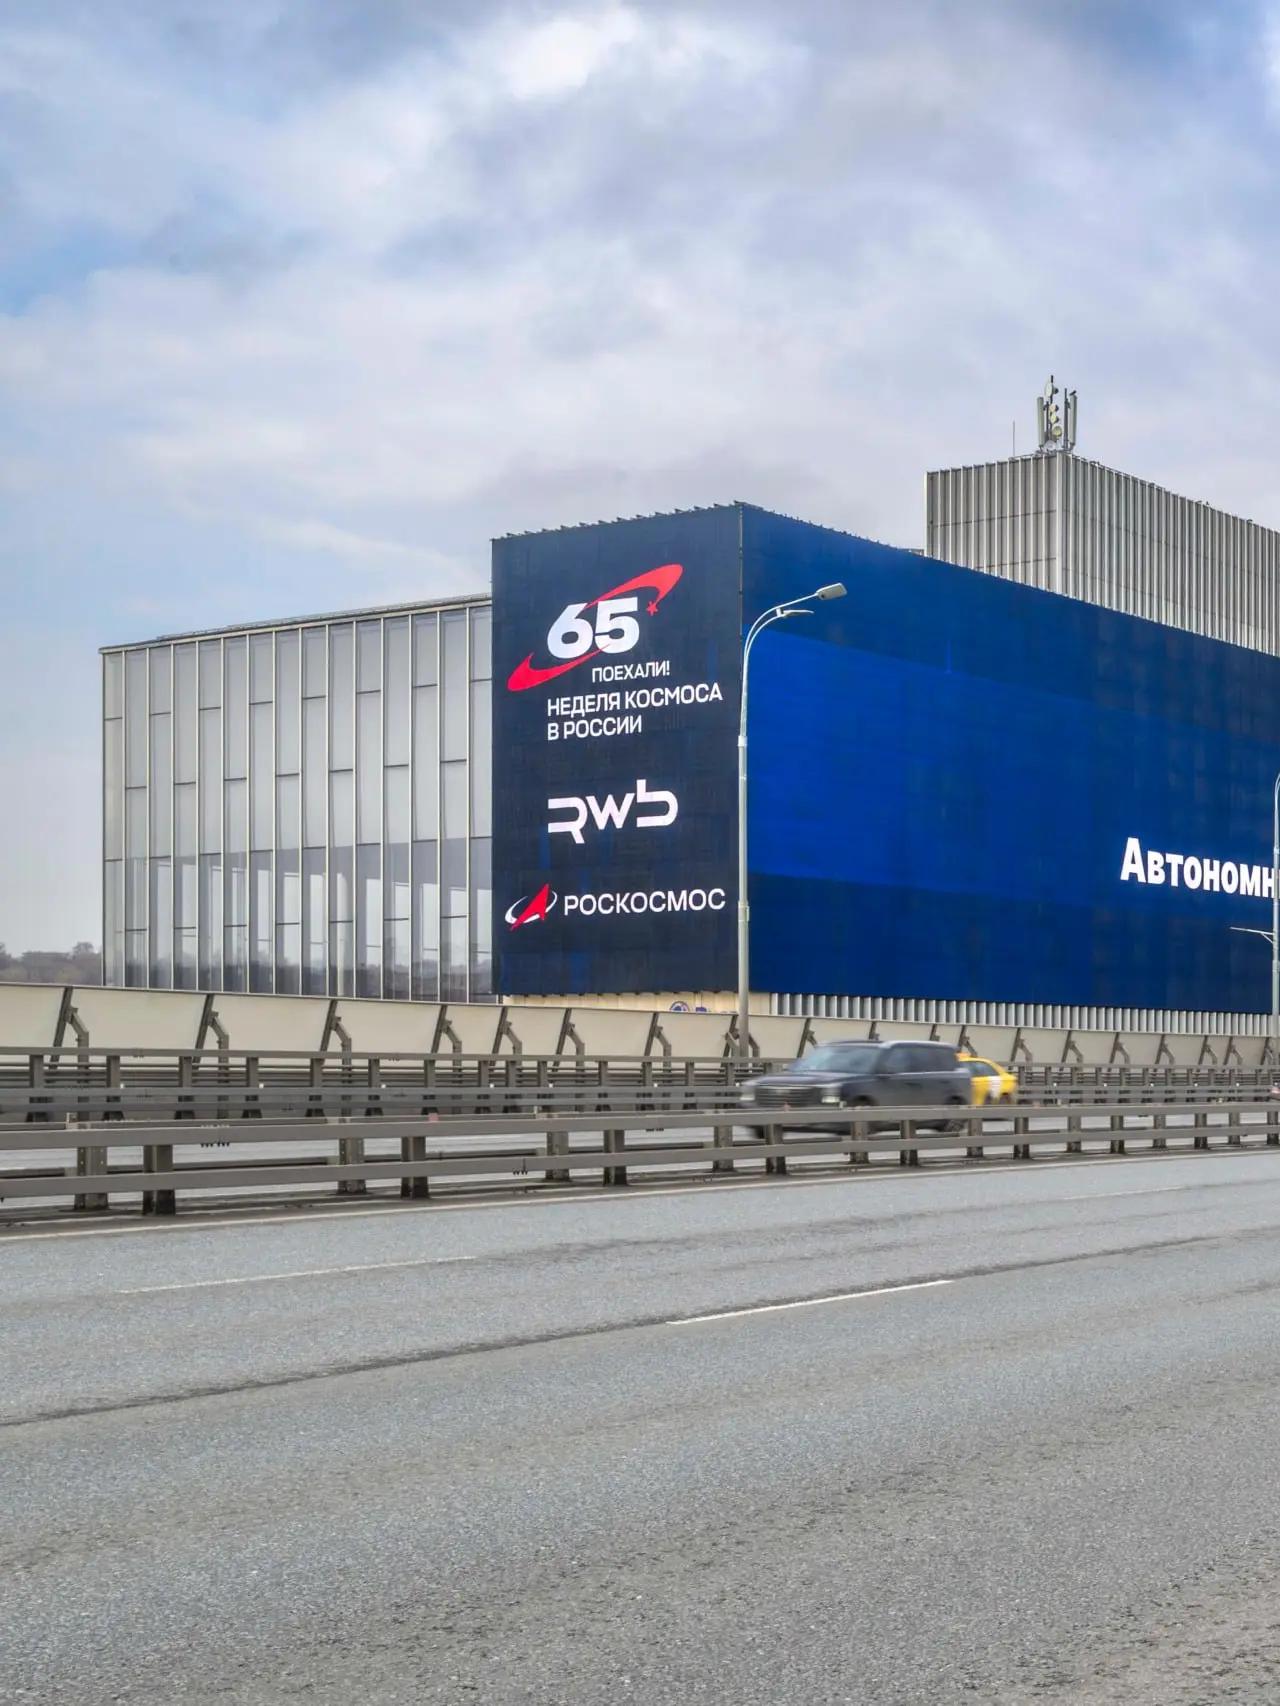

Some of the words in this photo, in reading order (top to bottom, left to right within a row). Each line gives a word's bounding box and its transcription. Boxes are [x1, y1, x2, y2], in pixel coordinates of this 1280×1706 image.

[547, 597, 639, 658] 65
[592, 660, 670, 683] ПОЕХАЛИ!
[547, 692, 621, 718] НЕДЕЛЯ
[625, 682, 723, 709] КОСМОСА
[547, 722, 560, 741] В
[563, 715, 642, 740] РОССИИ
[564, 888, 725, 916] РОСКОСМОС
